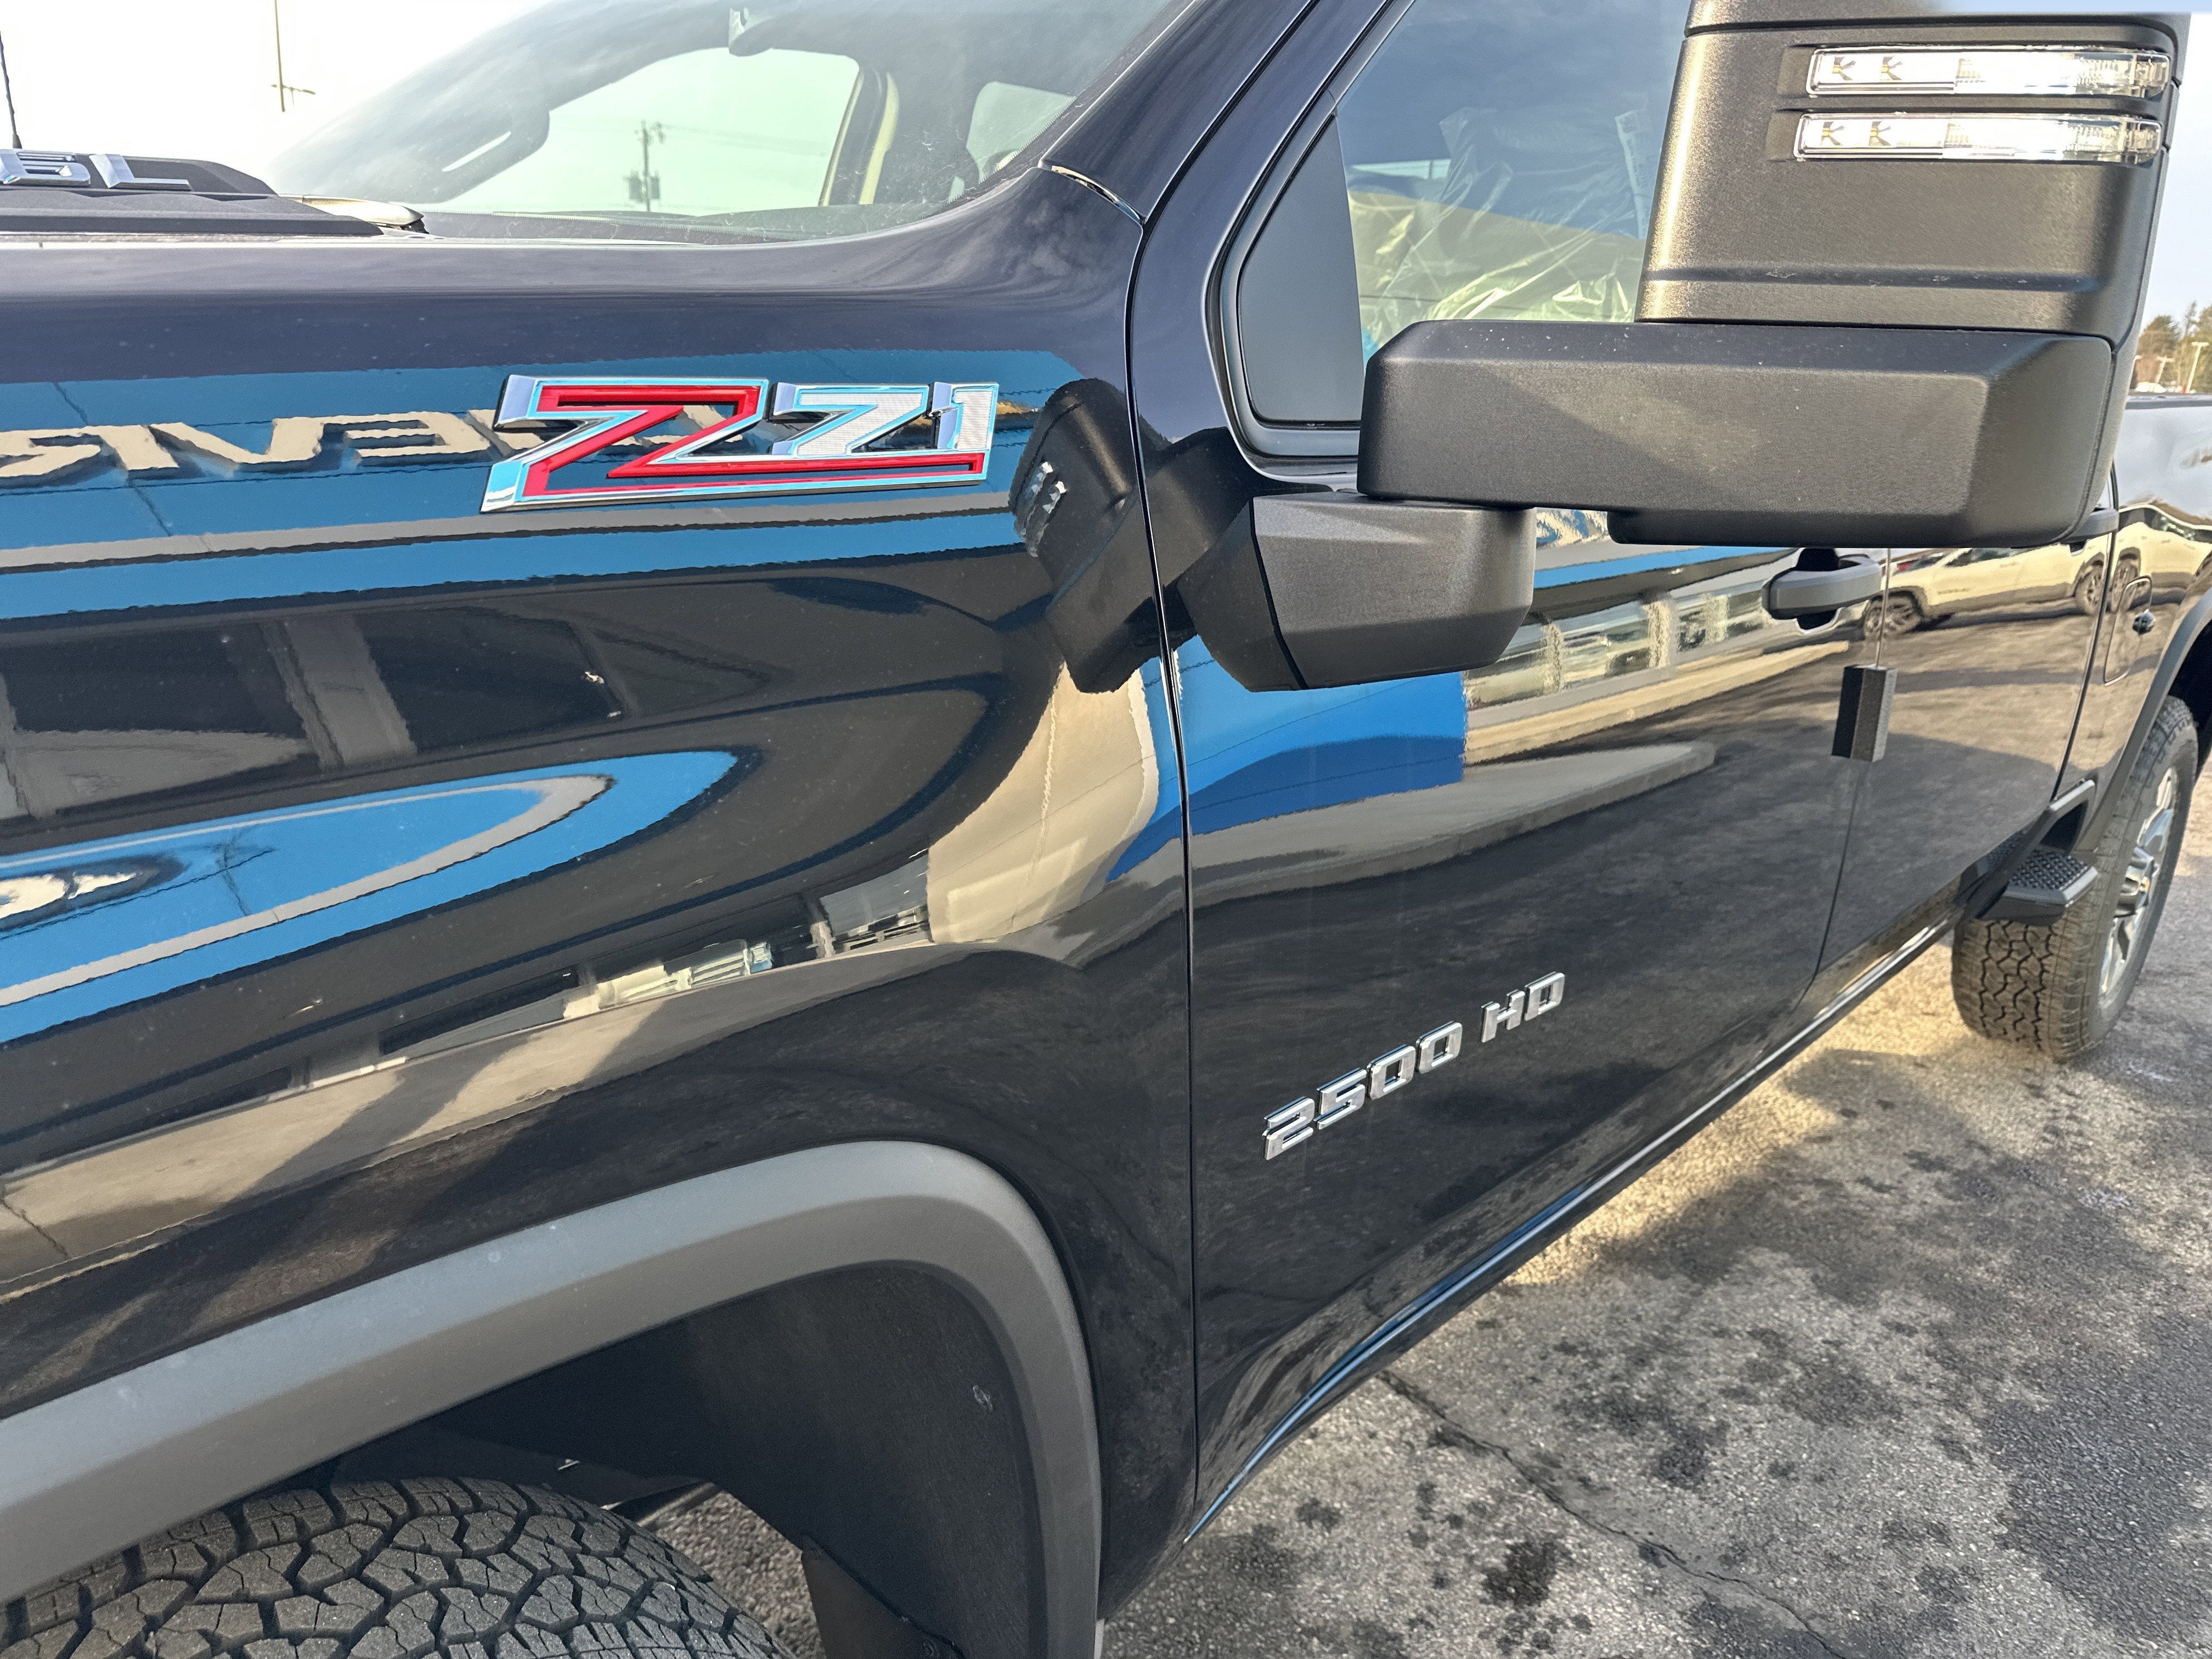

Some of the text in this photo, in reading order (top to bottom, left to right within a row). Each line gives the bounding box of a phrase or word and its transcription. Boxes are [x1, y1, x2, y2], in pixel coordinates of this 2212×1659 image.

[479, 374, 1000, 513] Z71
[1262, 971, 1565, 1161] 2500 HD
